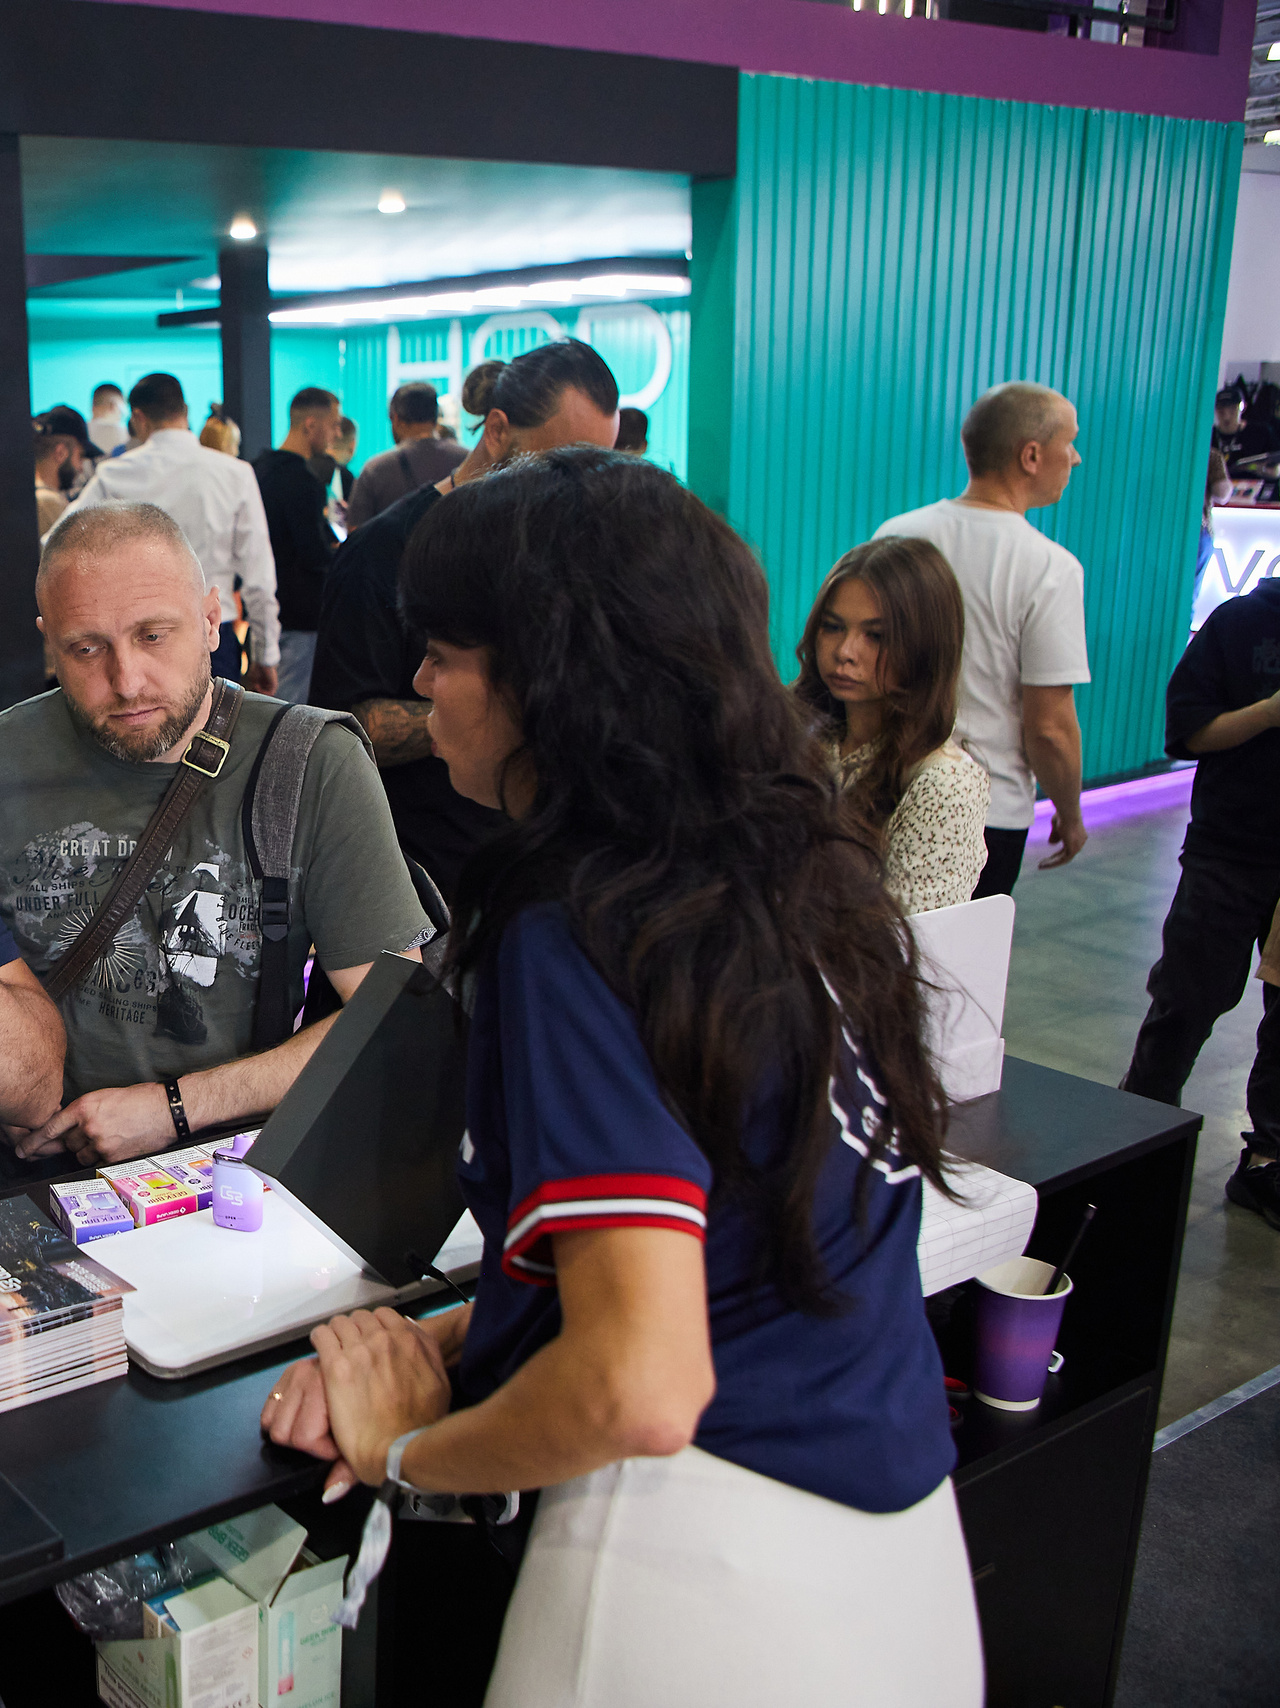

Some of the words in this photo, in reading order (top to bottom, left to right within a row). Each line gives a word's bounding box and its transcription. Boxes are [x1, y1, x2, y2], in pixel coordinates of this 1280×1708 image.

[1213, 548, 1280, 594] V
[52, 881, 85, 890] SHIPS
[16, 897, 61, 910] UNDER
[99, 1001, 146, 1025] HERITAGE
[100, 1214, 125, 1222] GEEK
